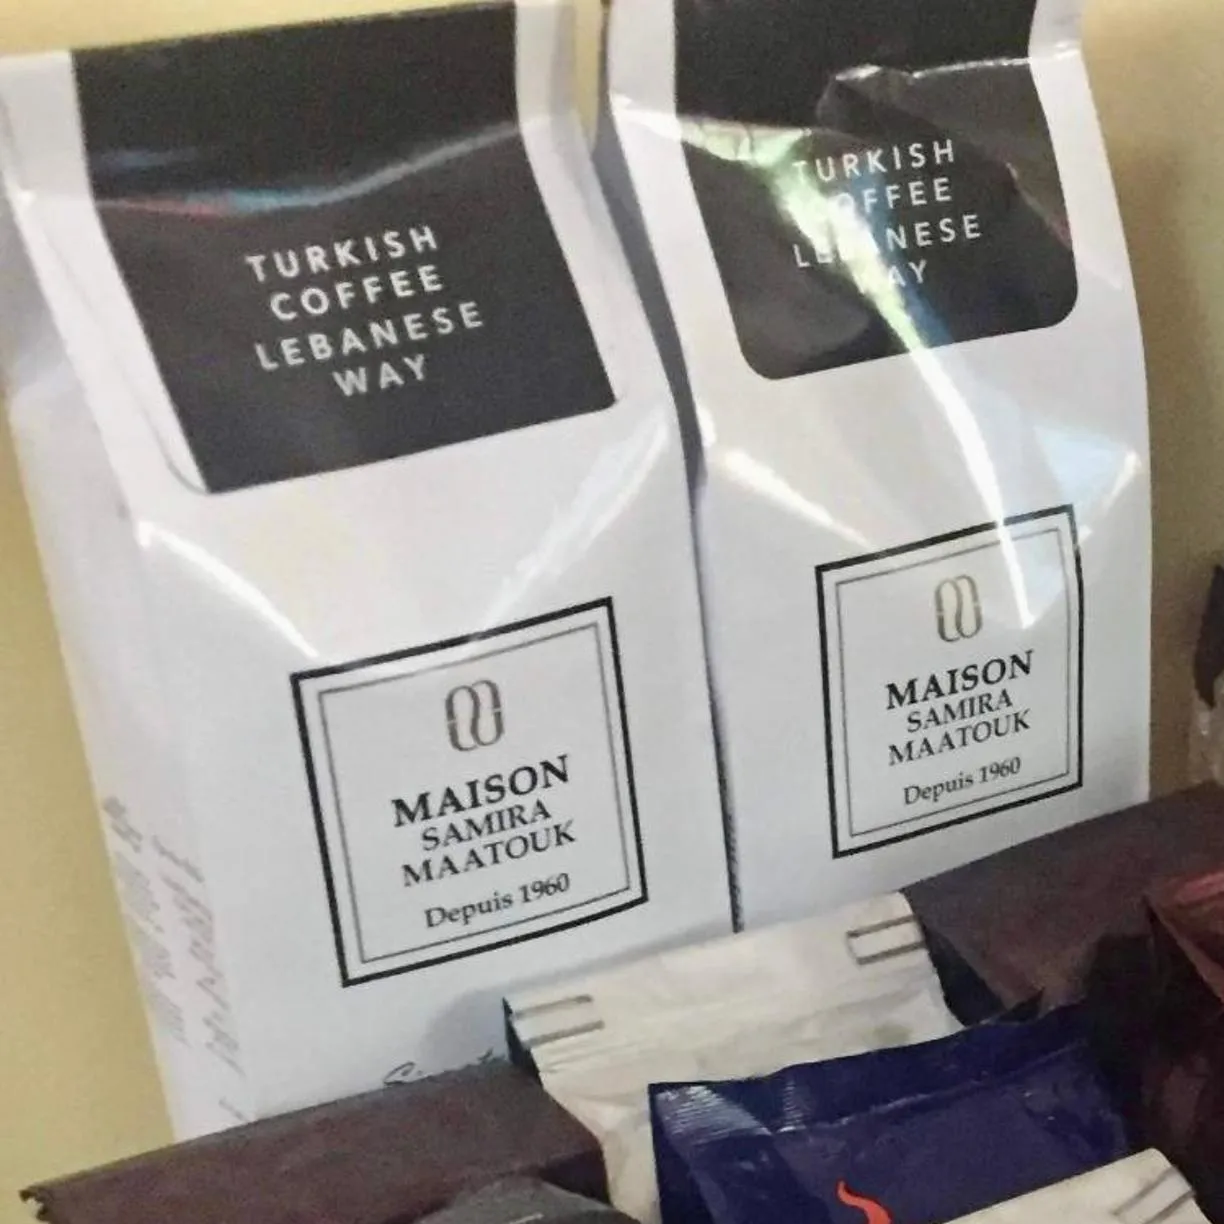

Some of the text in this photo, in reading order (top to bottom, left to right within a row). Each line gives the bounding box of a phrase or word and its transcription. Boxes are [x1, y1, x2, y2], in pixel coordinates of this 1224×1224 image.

[793, 138, 955, 182] TURKISH
[815, 176, 953, 220] OFFEE
[244, 224, 440, 283] TURKISH
[268, 263, 445, 322] COFFEE
[254, 300, 485, 371] LEBANESE
[332, 353, 429, 397] WAY
[885, 649, 1035, 711] MAISON
[888, 708, 1031, 767] MAATOUK
[907, 688, 1013, 734] SAMIRA
[390, 754, 571, 828] MAISON
[903, 756, 1021, 805] Depuis 1960
[400, 820, 577, 888] MAATOUK
[420, 798, 552, 852] SAMIRA
[424, 872, 571, 929] Depuis 1960
